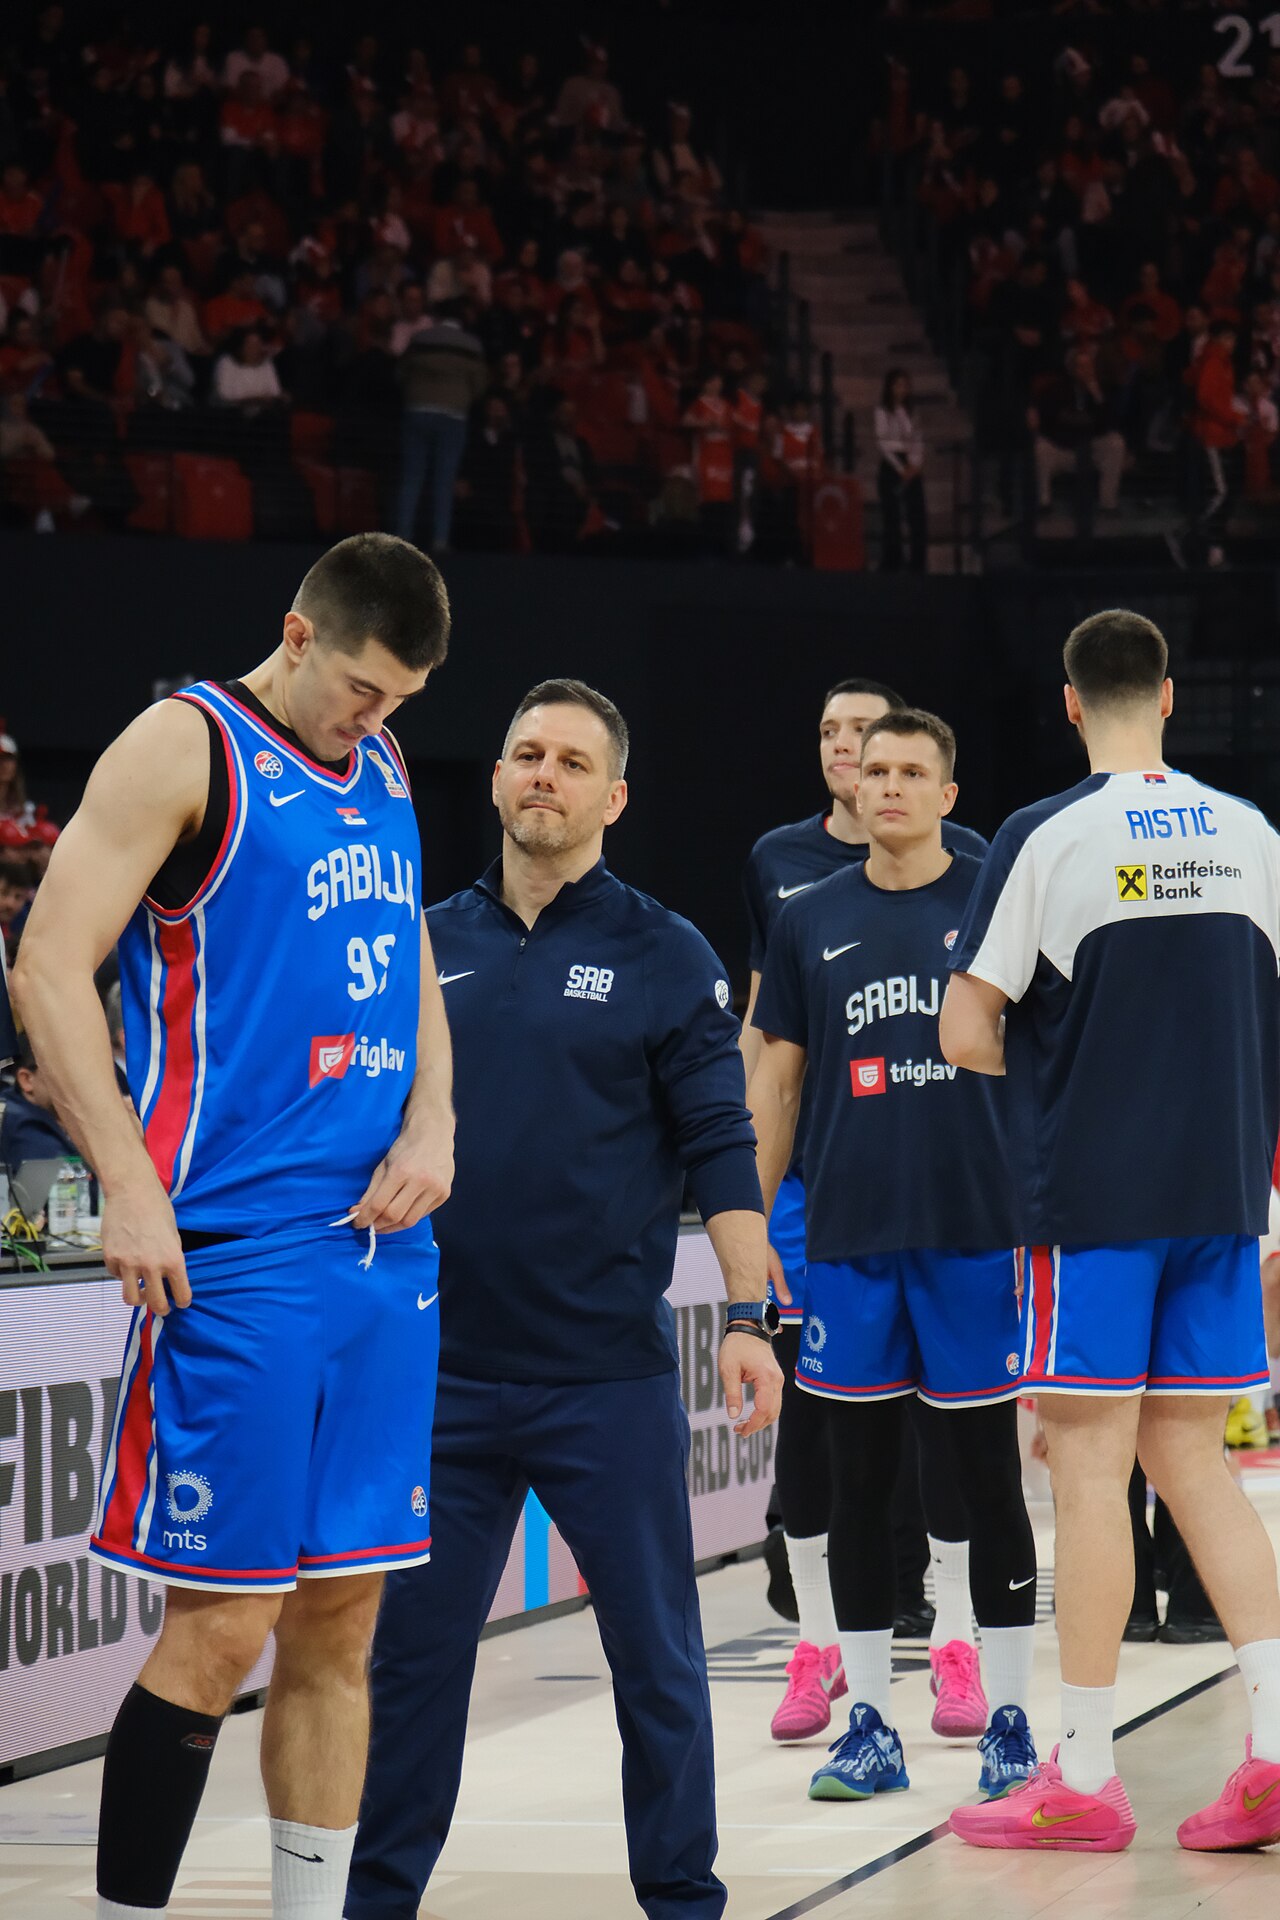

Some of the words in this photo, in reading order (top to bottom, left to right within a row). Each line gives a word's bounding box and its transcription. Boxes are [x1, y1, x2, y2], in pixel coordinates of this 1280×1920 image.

[1125, 801, 1218, 840] RISTIĆ
[1152, 860, 1242, 880] Raiffeisen
[1153, 881, 1203, 900] Bank
[566, 964, 615, 994] SRB
[563, 988, 608, 1003] BASKETBALL
[846, 975, 948, 1036] SRBIJ
[890, 1059, 958, 1087] triglav
[801, 1355, 823, 1374] mts
[162, 1528, 207, 1551] mts
